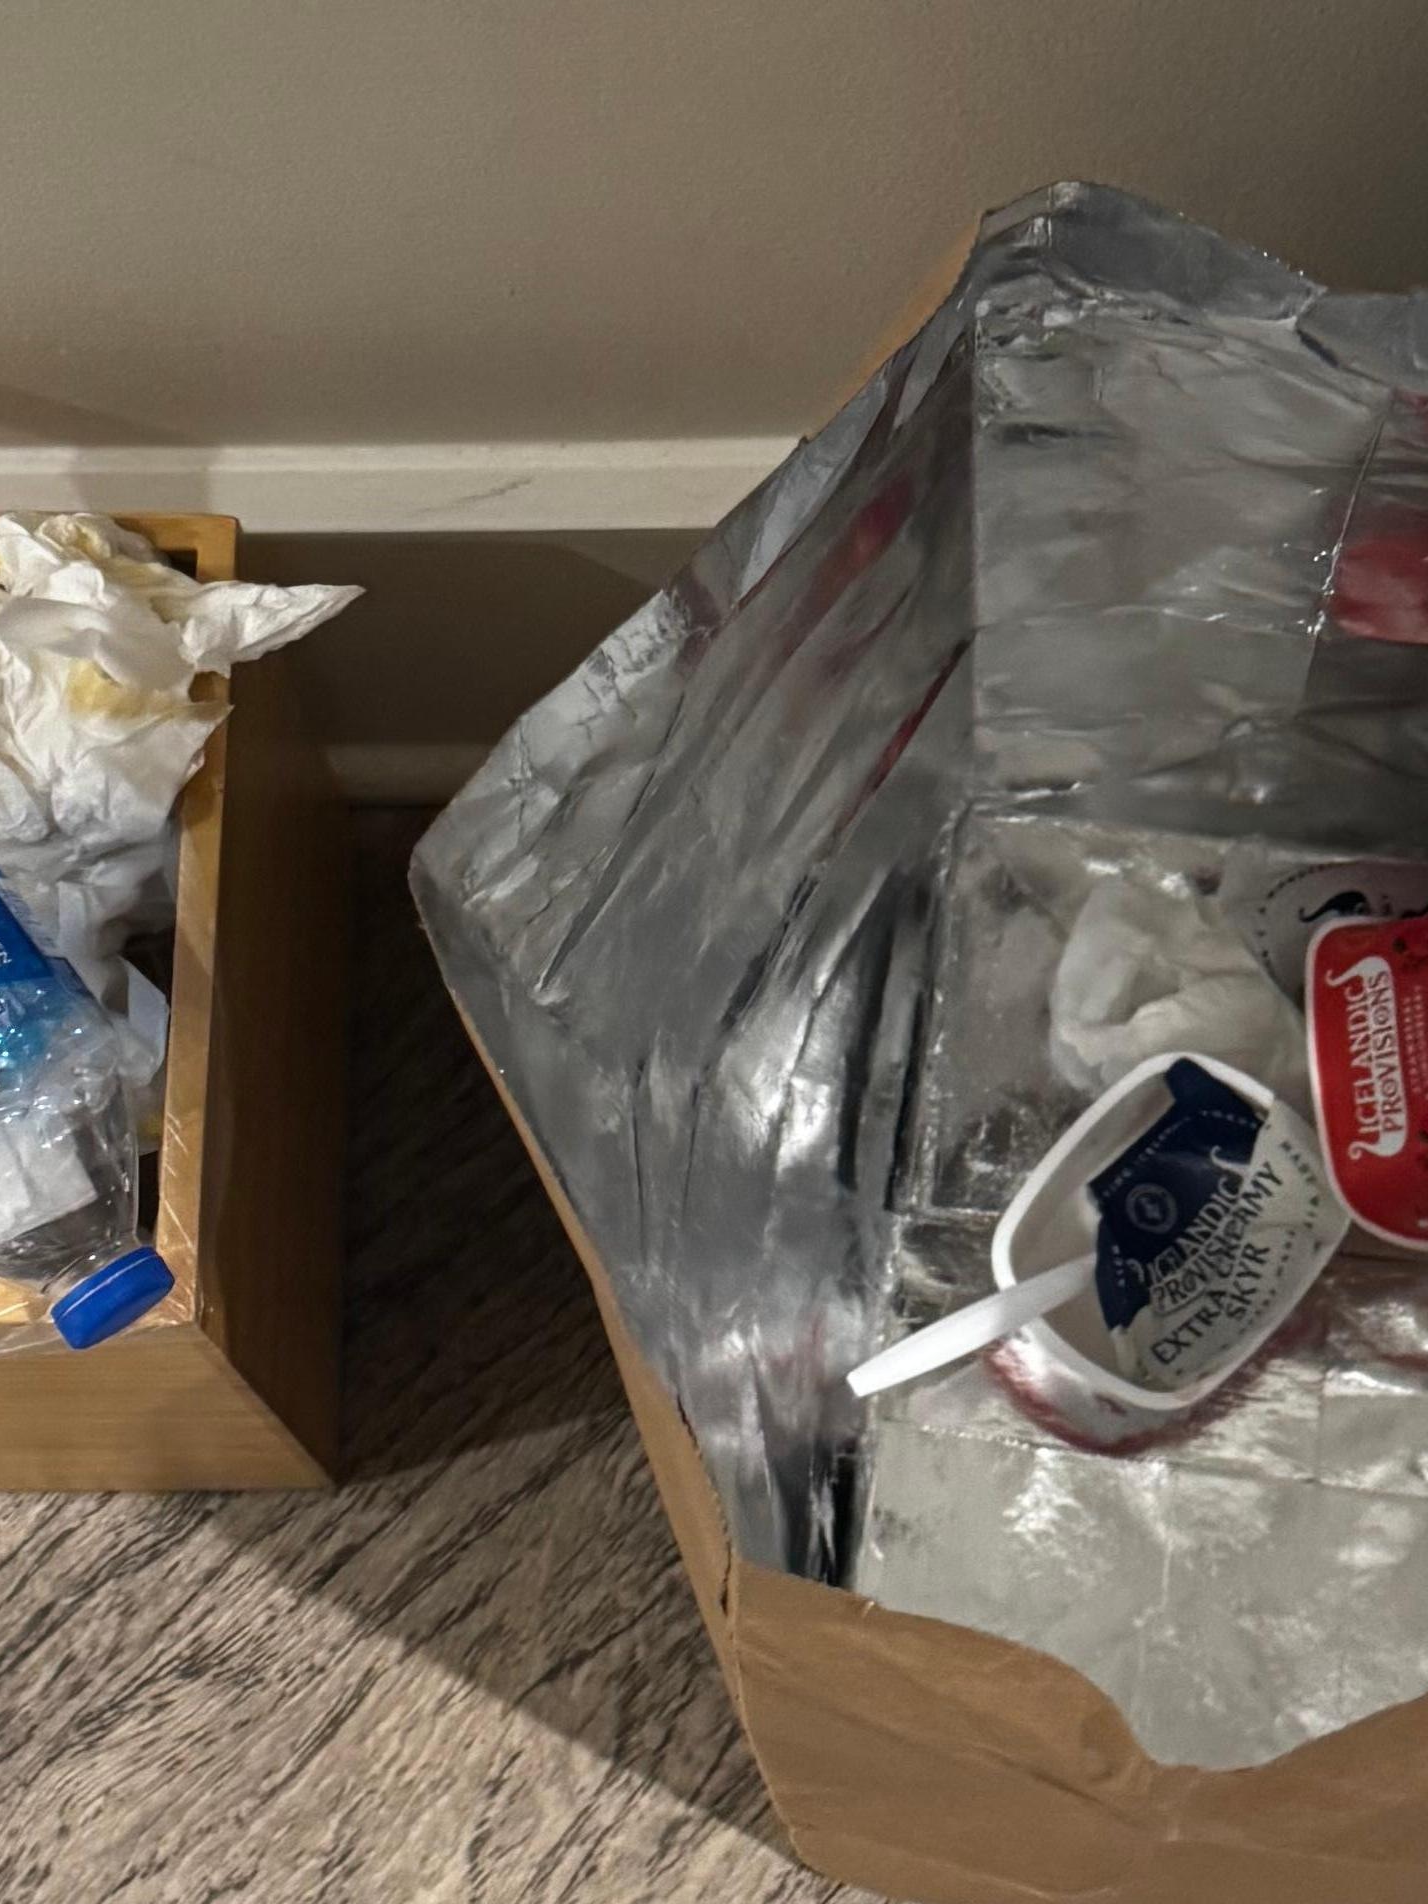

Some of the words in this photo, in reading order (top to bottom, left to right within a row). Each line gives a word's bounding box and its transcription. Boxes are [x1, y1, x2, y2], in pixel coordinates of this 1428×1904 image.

[1344, 973, 1382, 1135] ICELANDIC
[1368, 970, 1404, 1134] PROVISIONS
[1150, 1288, 1228, 1365] EXTRA
[1225, 1242, 1271, 1322] SKYR
